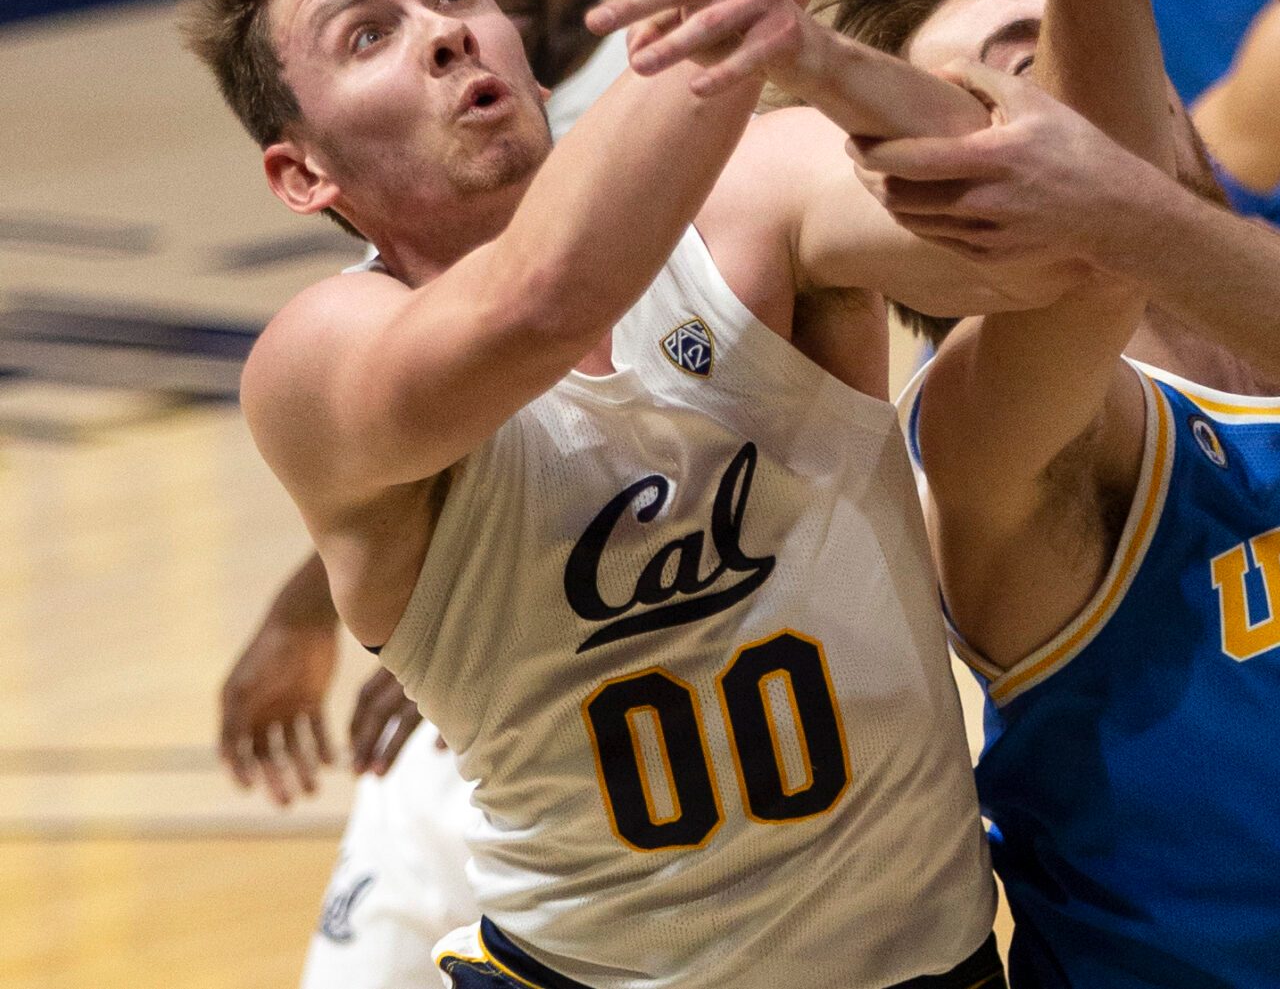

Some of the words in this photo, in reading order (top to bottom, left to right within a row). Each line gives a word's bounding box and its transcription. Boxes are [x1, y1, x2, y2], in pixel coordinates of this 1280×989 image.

[664, 321, 710, 366] PAC
[683, 344, 710, 371] 12
[564, 442, 776, 653] Cal
[581, 628, 852, 853] 00
